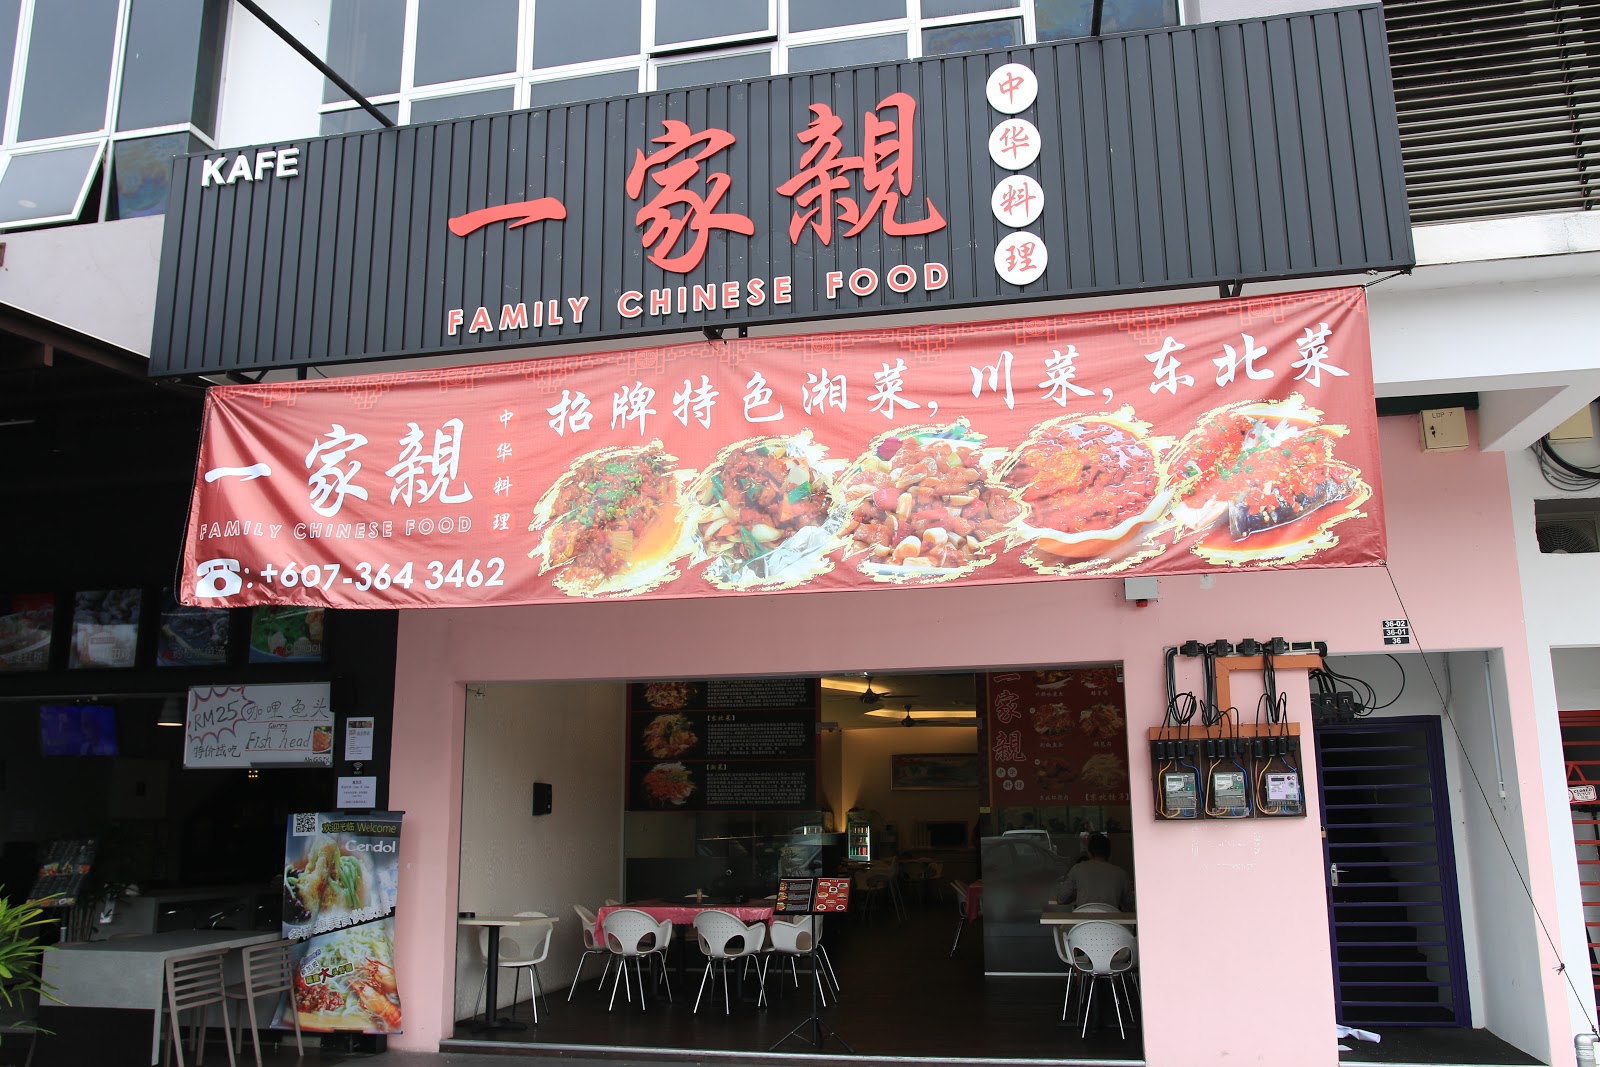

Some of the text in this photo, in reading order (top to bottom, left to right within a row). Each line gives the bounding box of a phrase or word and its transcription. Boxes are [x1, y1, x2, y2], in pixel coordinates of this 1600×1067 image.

[201, 147, 300, 188] KAFE
[448, 91, 947, 274] 一家親
[996, 68, 1040, 276] 中华料理
[447, 262, 949, 336] FAMILY CHINESE FOOD
[204, 417, 474, 518] 一家親
[491, 408, 514, 532] 中华料理
[199, 516, 473, 541] FAMILY CHINESE FOOD
[424, 557, 505, 591] 3462
[1384, 620, 1406, 628] 36-02
[194, 699, 239, 731] RM25
[193, 744, 241, 759] 特价试吃
[245, 727, 312, 750] Fish head
[322, 821, 397, 834] 欢迎光临 Welcome
[344, 839, 396, 853] Cendol
